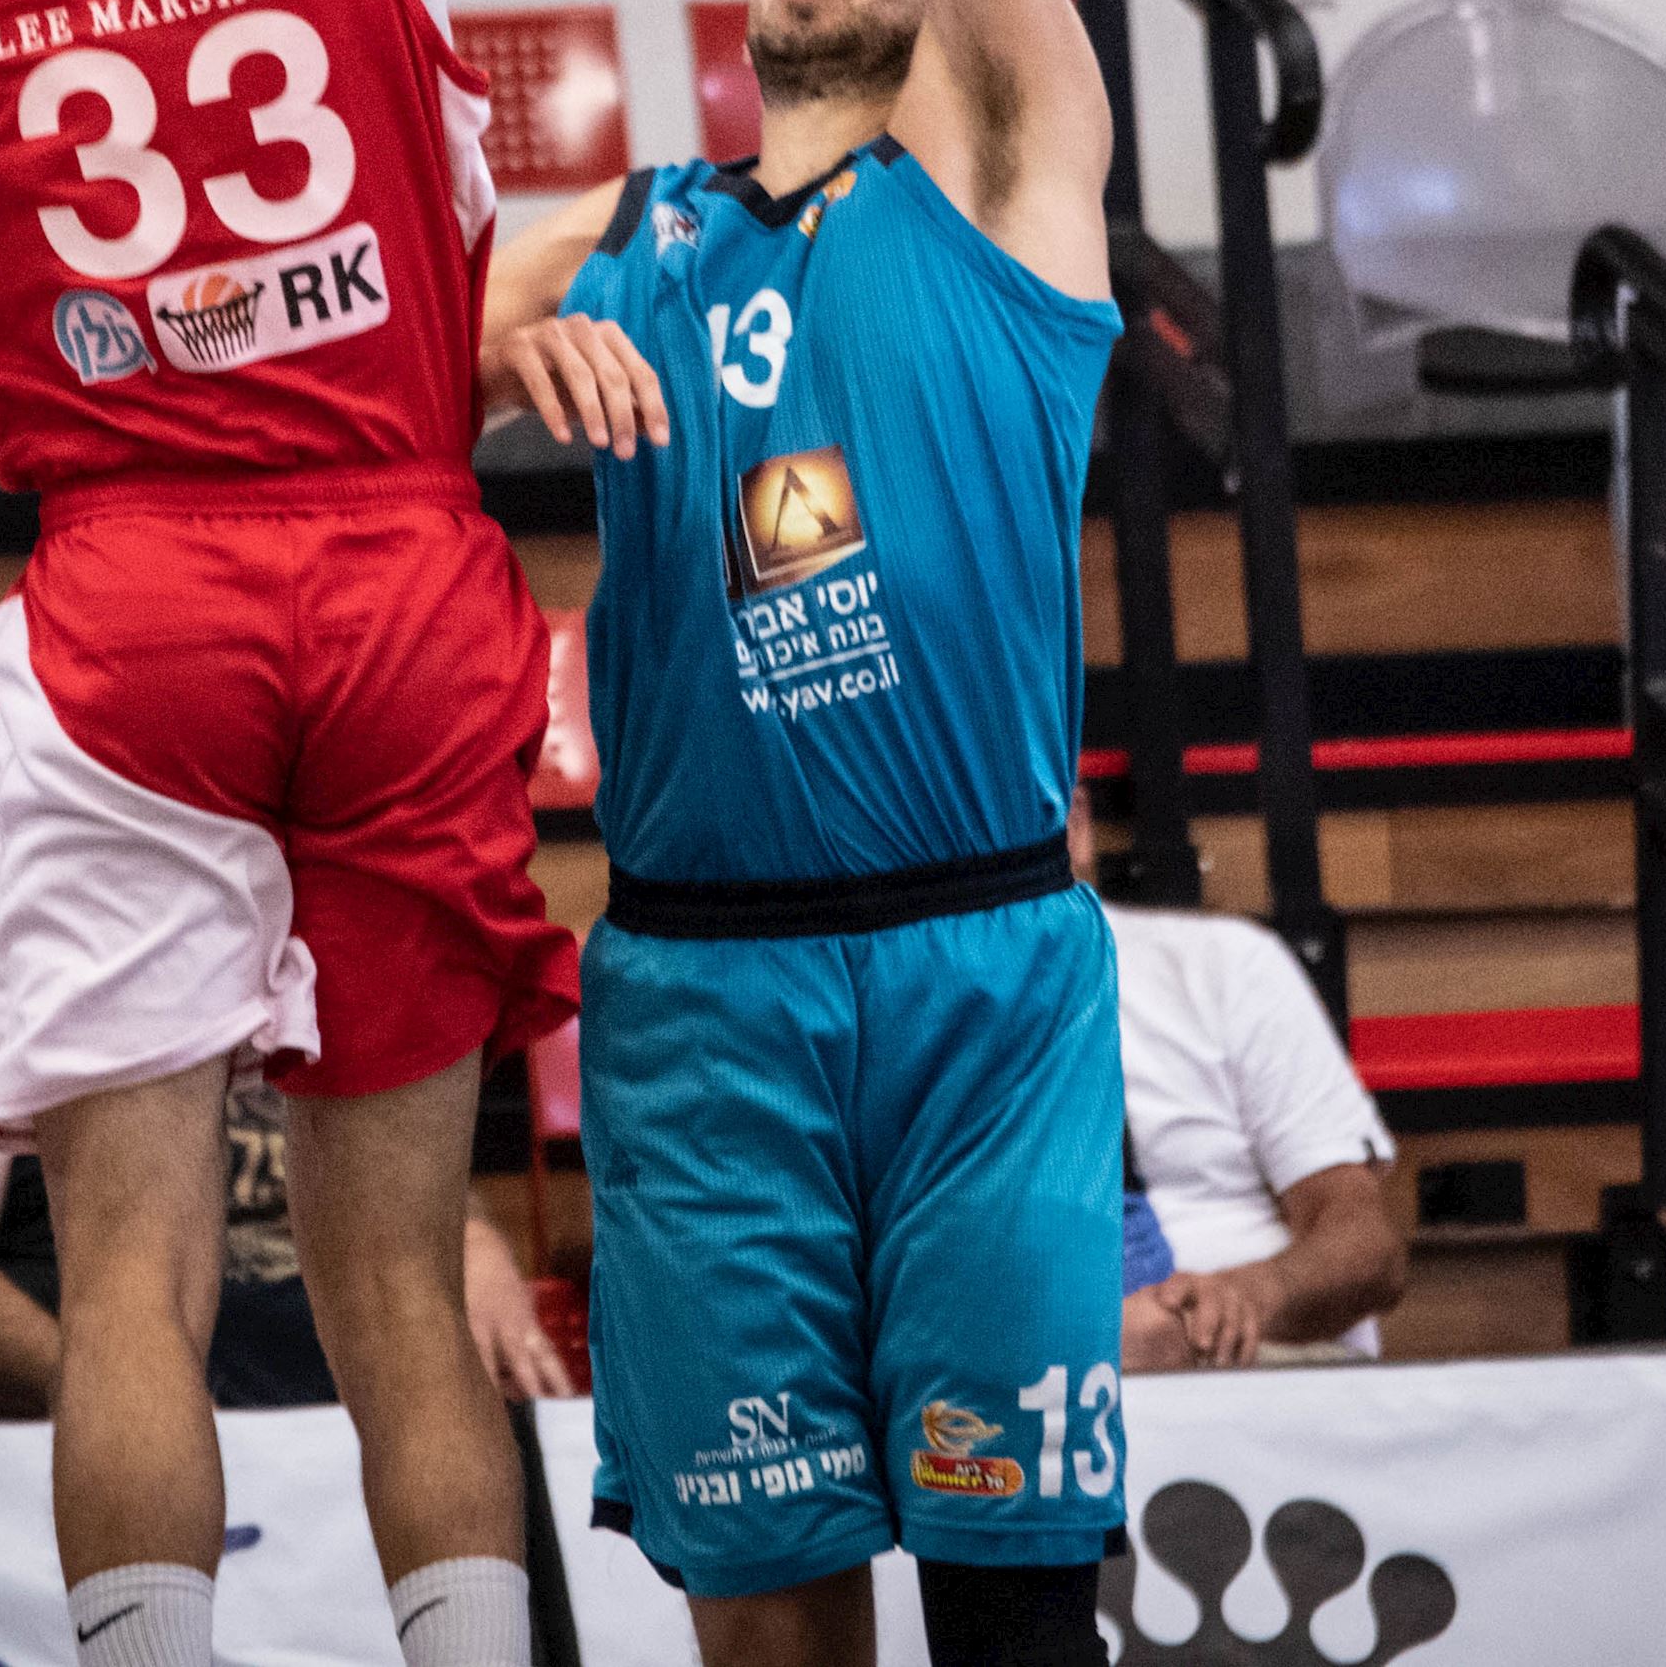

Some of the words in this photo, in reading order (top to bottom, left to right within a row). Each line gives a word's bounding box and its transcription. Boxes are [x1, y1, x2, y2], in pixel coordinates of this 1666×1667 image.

[17, 9, 357, 281] 33
[278, 238, 385, 330] RK
[706, 287, 794, 409] 13
[737, 592, 809, 640] אבר
[816, 571, 878, 616] יוסי
[728, 1390, 791, 1446] SN
[1018, 1361, 1118, 1499] 13
[749, 1456, 815, 1499] נופי
[819, 1442, 866, 1481] סמי
